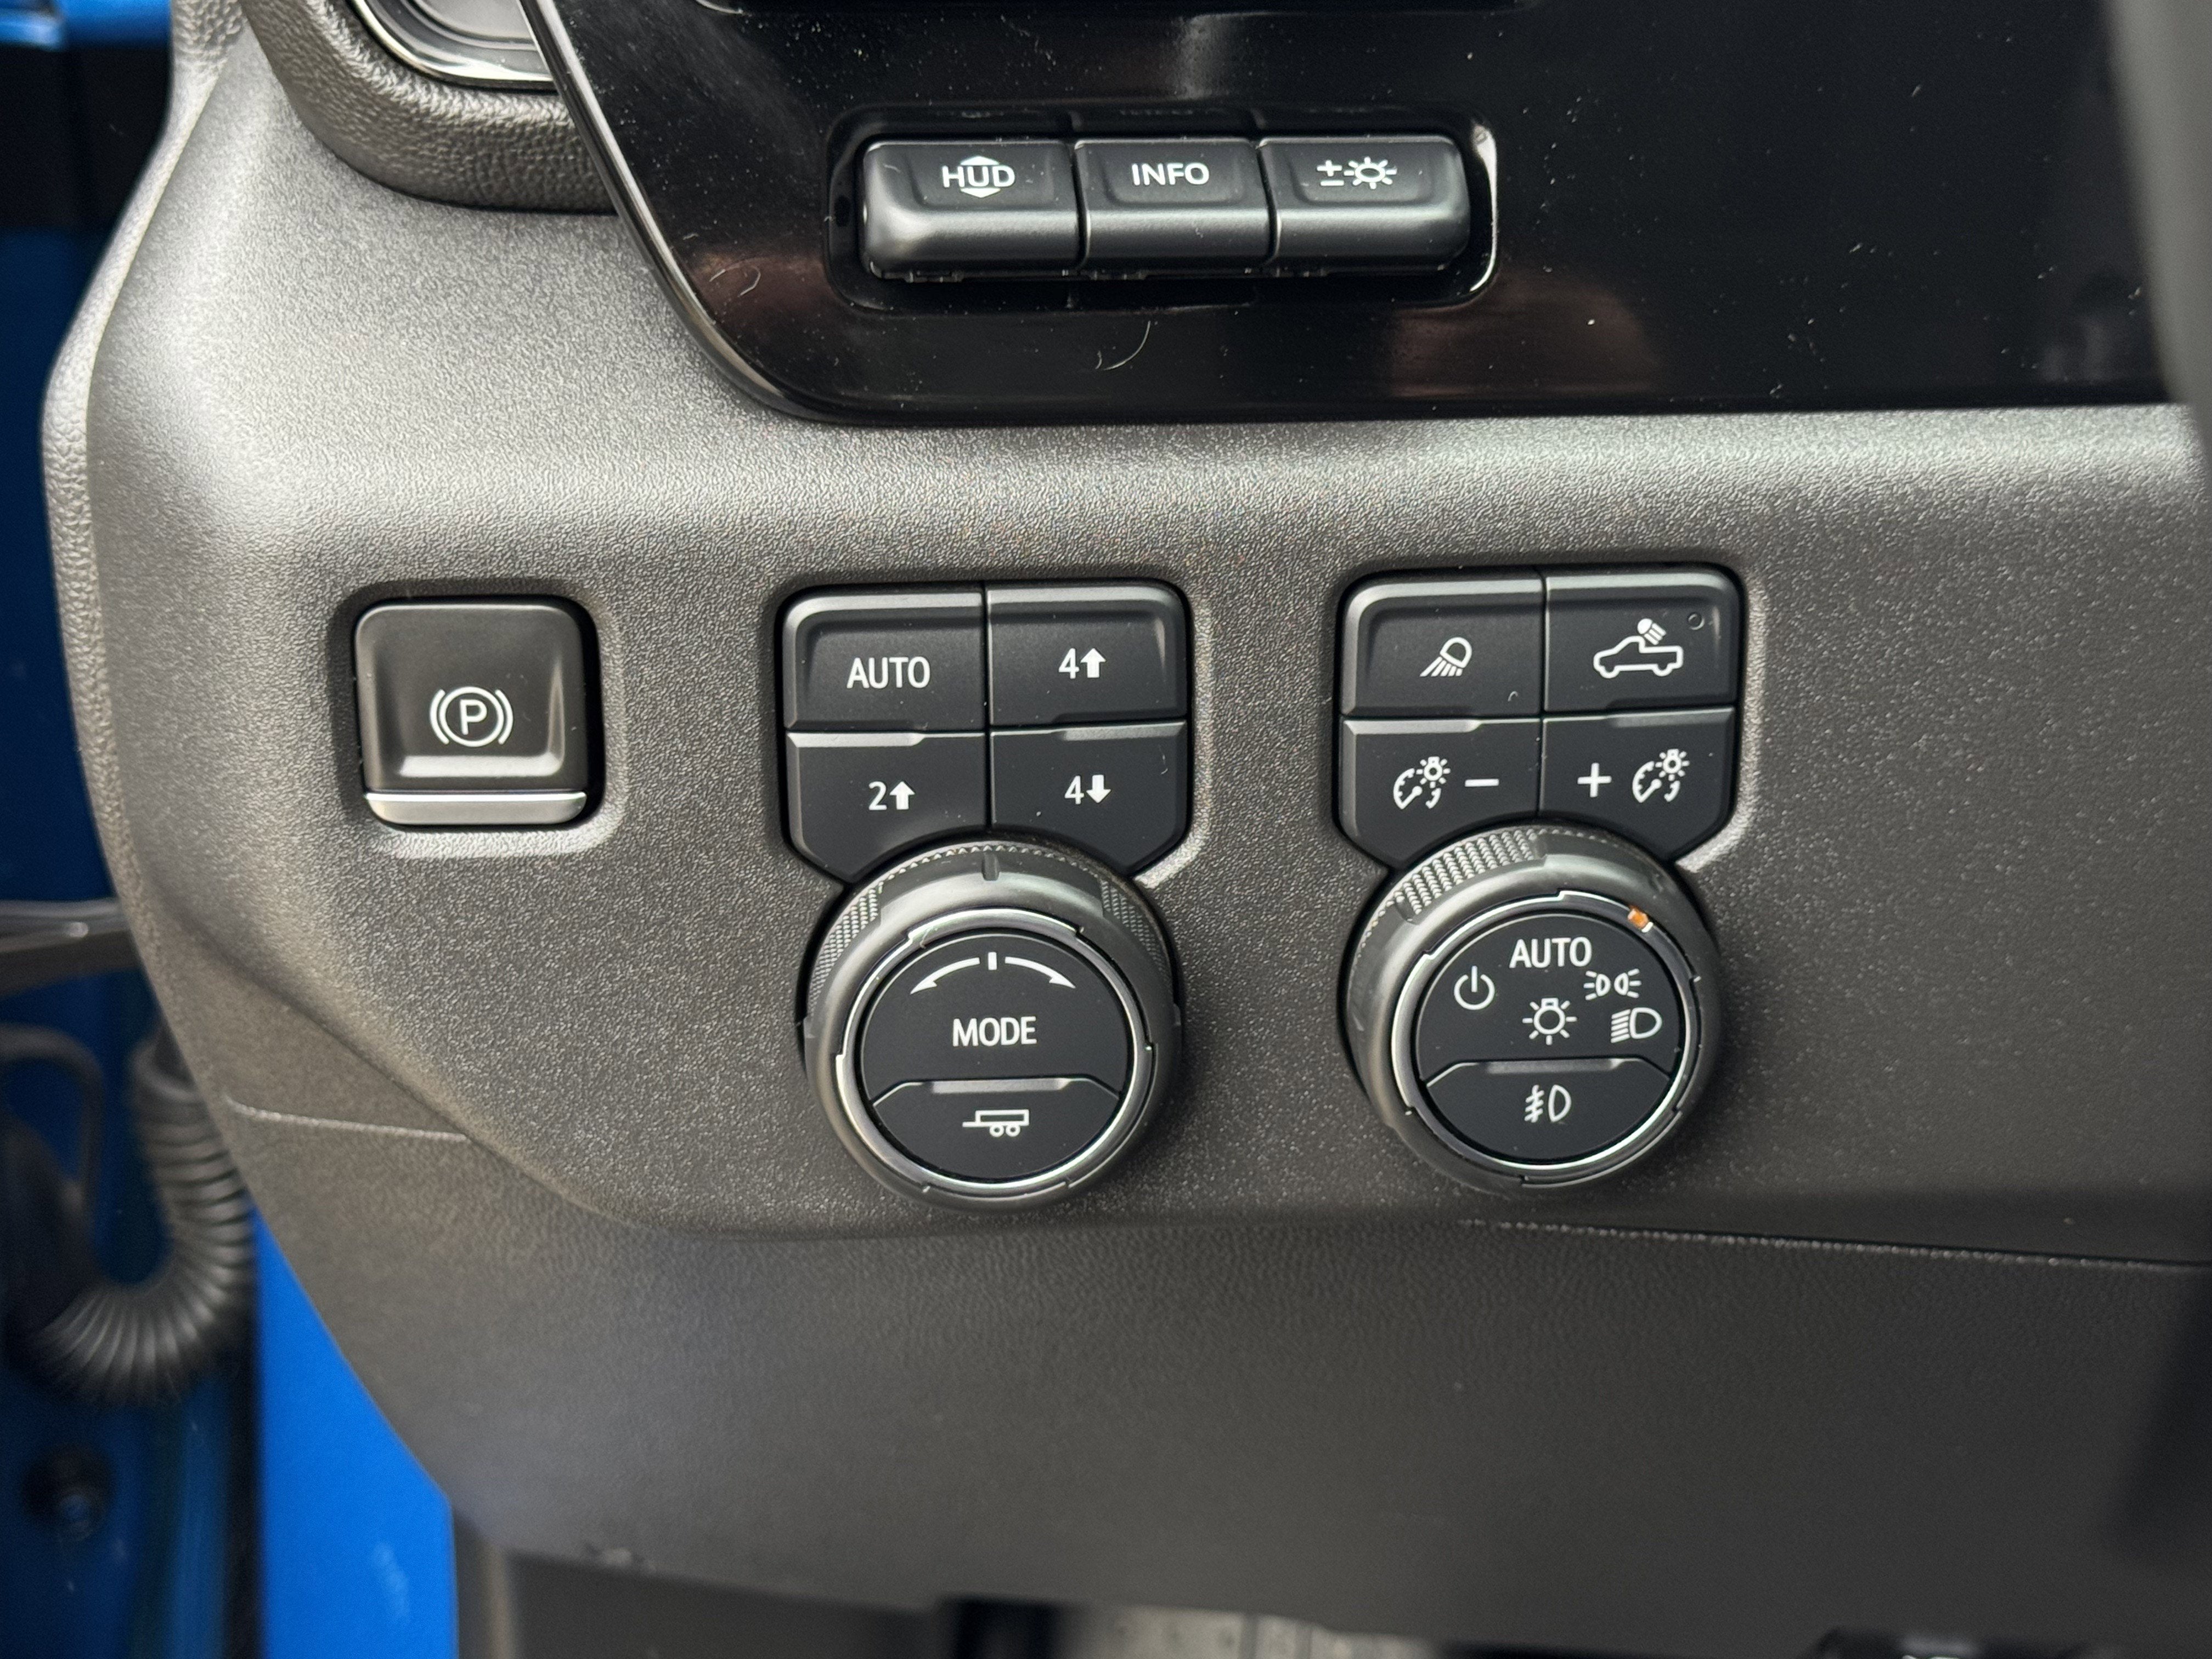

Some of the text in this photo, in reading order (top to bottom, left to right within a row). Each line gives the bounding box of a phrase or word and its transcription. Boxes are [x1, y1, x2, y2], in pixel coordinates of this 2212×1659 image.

[942, 165, 1015, 188] HUD
[1132, 162, 1210, 186] INFO
[847, 656, 930, 689] AUTO
[1059, 648, 1079, 679] 4
[460, 699, 487, 735] P
[869, 781, 887, 810] 2
[1065, 776, 1084, 804] 4
[1509, 937, 1592, 968] AUTO
[953, 1017, 1037, 1046] MODE
